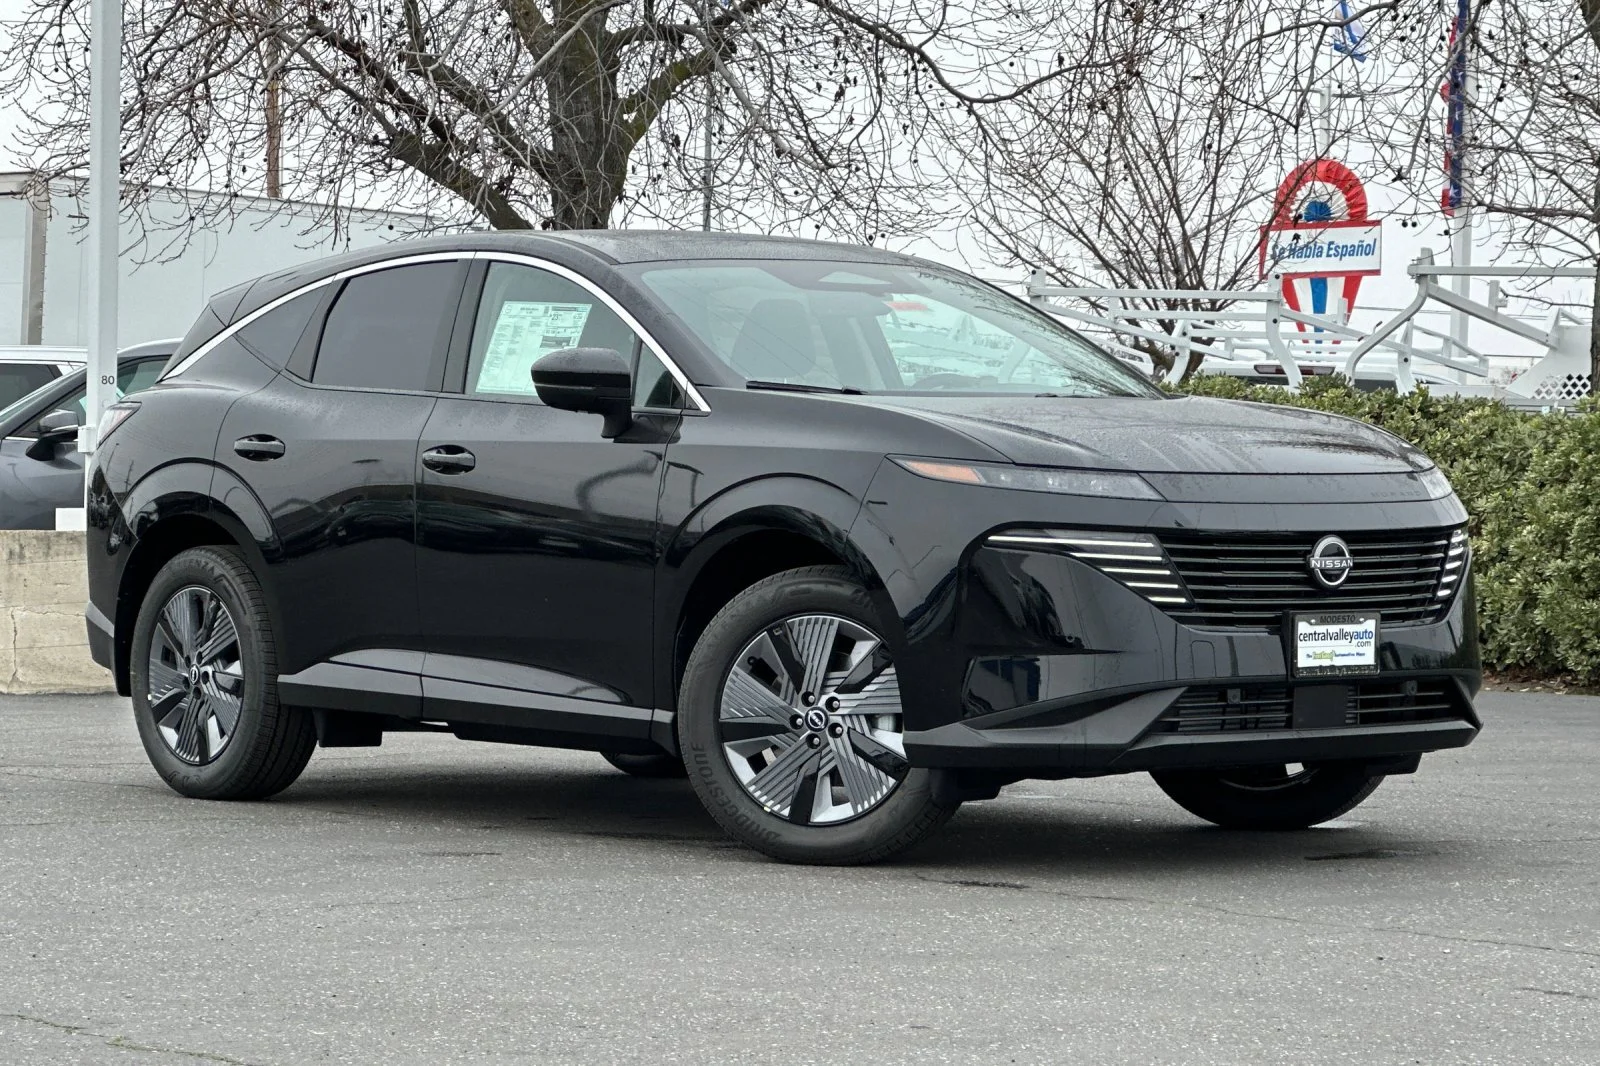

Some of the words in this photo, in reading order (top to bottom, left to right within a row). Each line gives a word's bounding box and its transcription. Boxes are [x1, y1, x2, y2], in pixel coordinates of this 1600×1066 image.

[1272, 244, 1285, 259] Se
[1287, 241, 1323, 259] Habla
[1325, 238, 1377, 261] Español
[101, 375, 115, 385] 80
[1311, 559, 1353, 568] NISSAN
[1319, 614, 1356, 624] MODESTO
[1298, 628, 1374, 644] centralvalleyauto
[1354, 640, 1372, 648] .com
[691, 742, 782, 840] BRIDGESTONE
